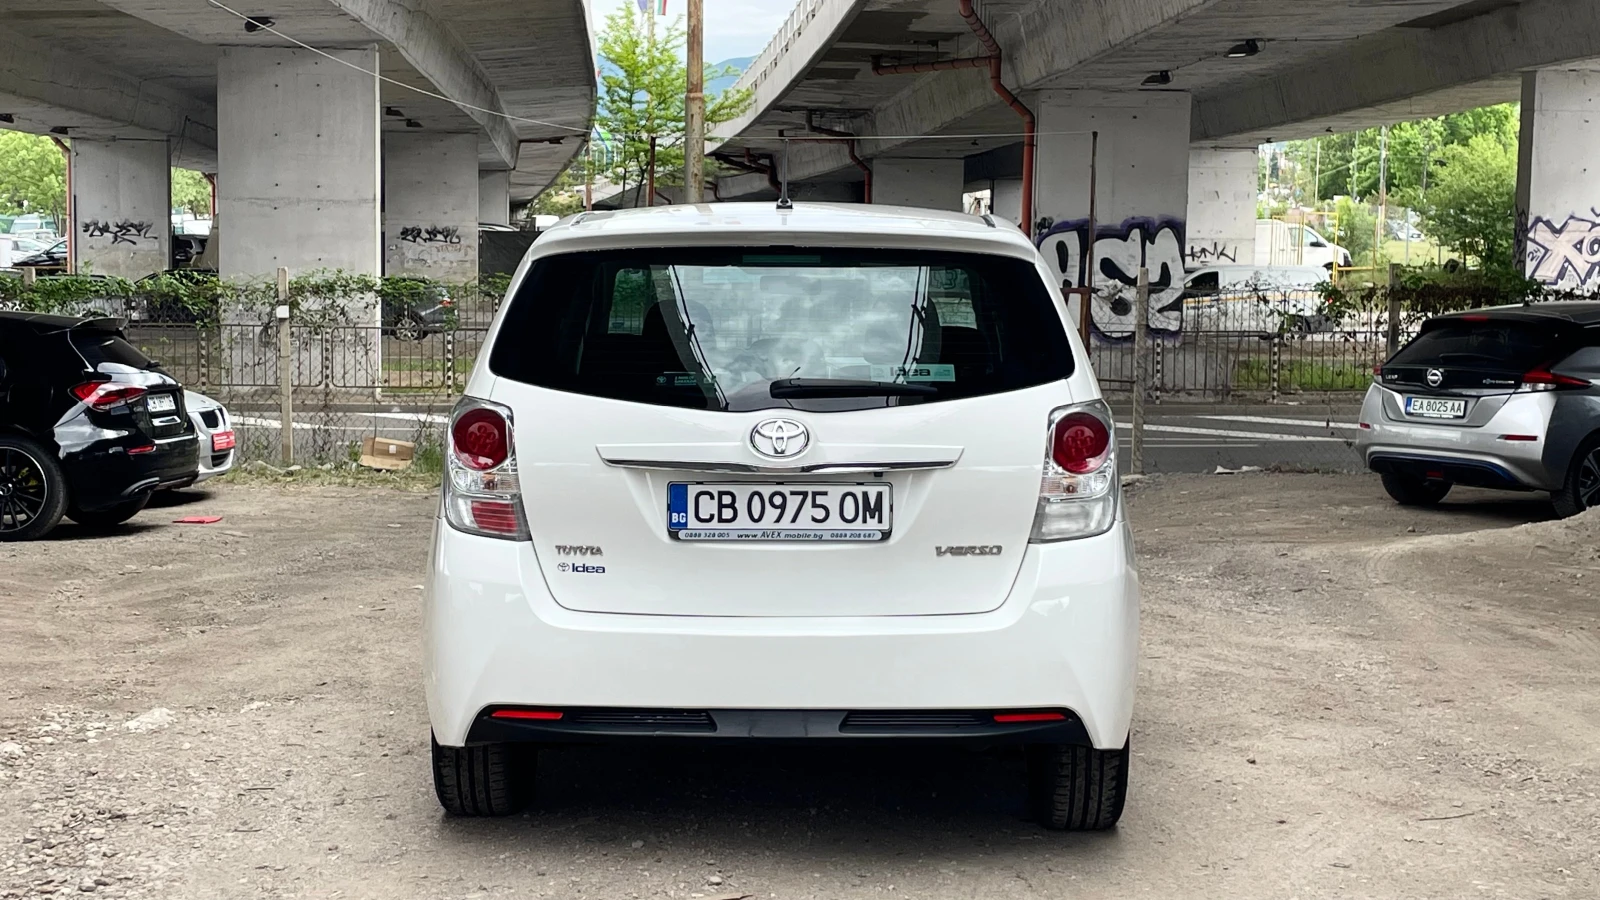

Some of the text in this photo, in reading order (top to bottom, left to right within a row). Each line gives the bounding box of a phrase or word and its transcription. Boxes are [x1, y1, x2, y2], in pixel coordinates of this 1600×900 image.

[1412, 400, 1462, 414] EA 8025 AA
[694, 490, 883, 524] CB 0975 OM
[671, 512, 686, 523] BG
[554, 544, 604, 557] TOYOTA
[935, 545, 1003, 557] VERSO
[571, 562, 606, 574] Idea
